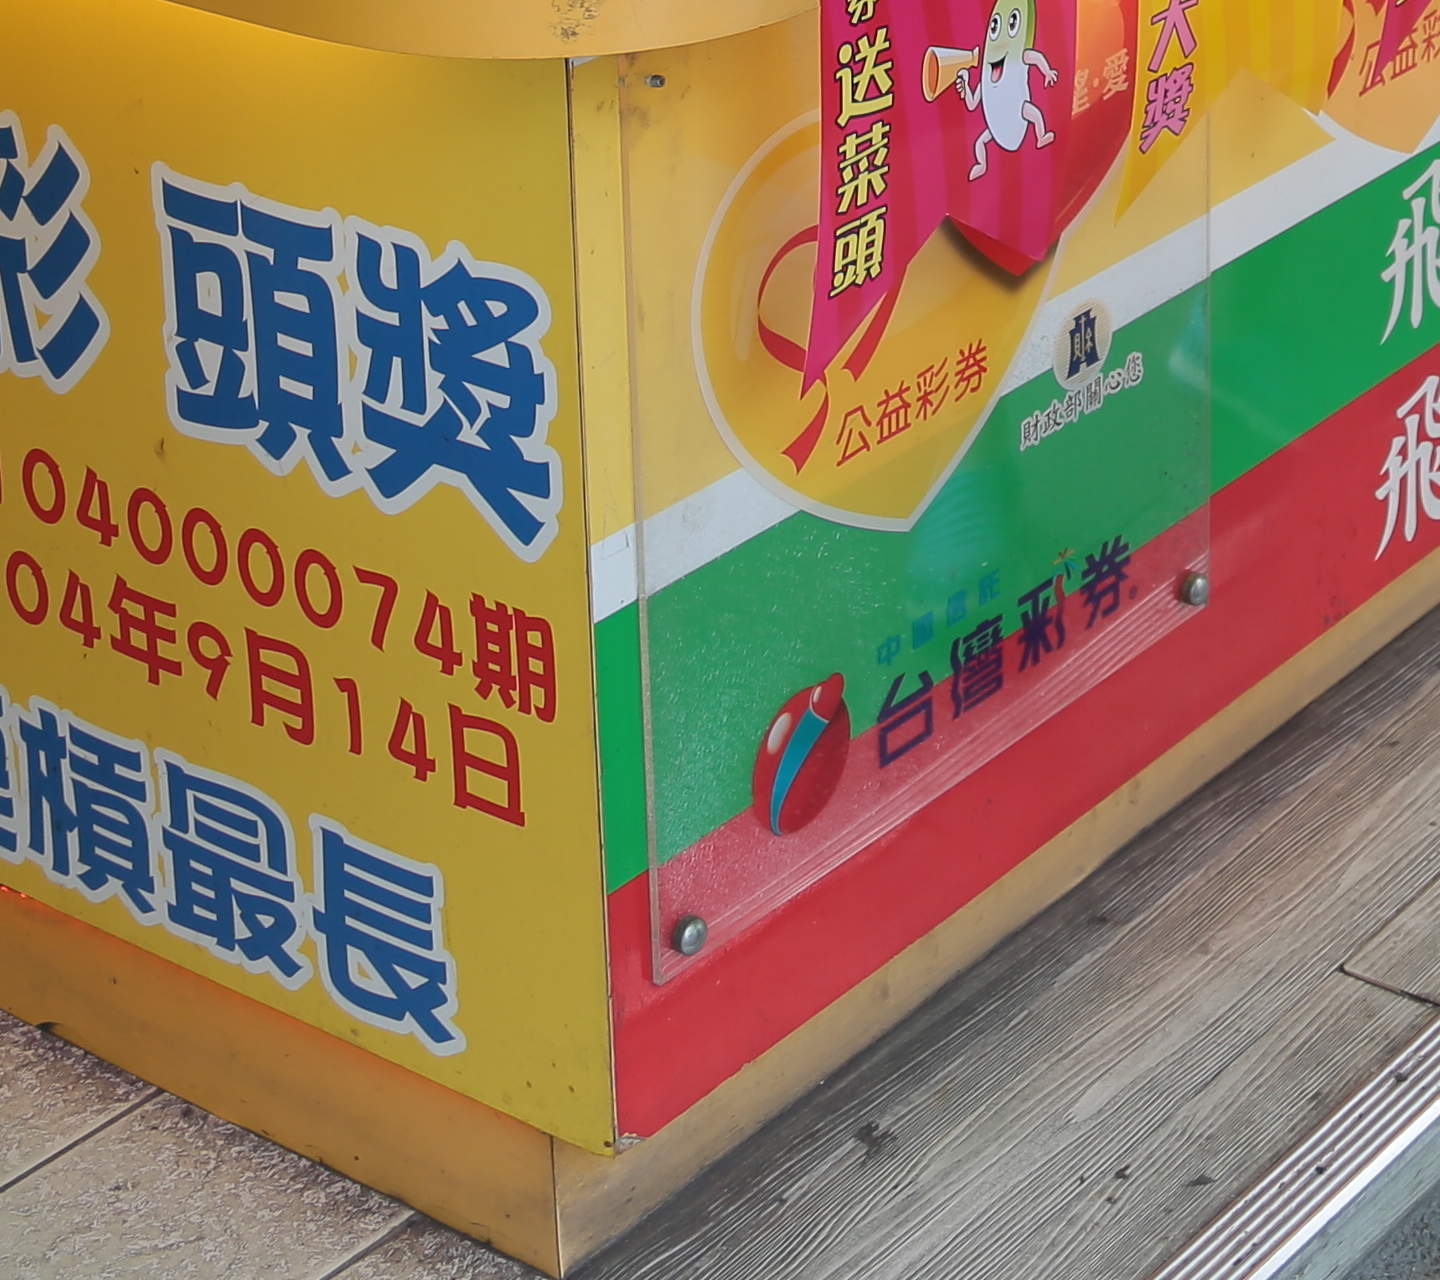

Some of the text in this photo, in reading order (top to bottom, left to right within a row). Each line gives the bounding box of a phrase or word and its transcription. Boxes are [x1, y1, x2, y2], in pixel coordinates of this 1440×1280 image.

[162, 179, 551, 546] 頭獎
[835, 339, 990, 469] 公益彩券
[1022, 353, 1143, 450] 財政部關心您
